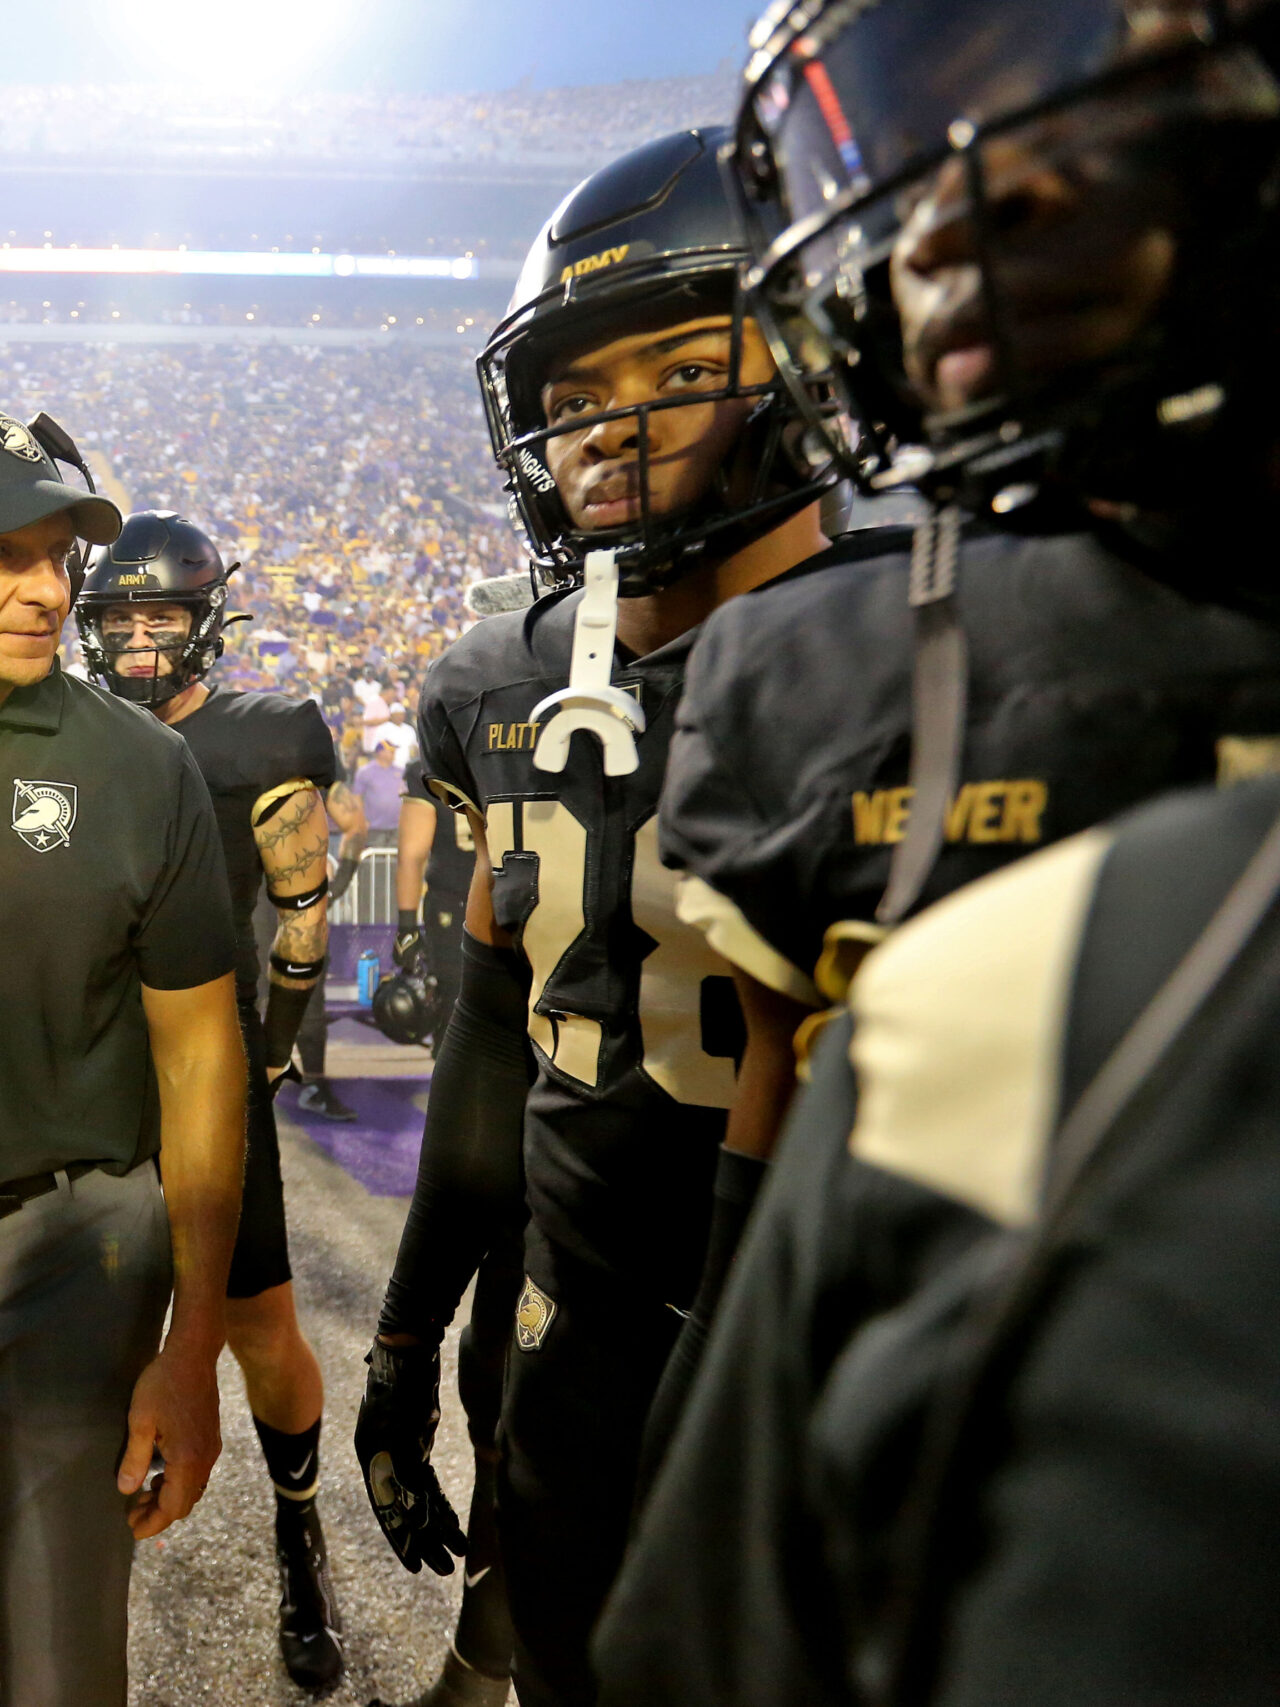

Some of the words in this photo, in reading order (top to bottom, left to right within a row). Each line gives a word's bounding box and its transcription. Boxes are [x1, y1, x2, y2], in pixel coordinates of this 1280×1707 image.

[561, 244, 630, 283] ARMY
[118, 574, 147, 586] ARMY
[489, 722, 541, 750] PLATT
[852, 780, 1048, 844] WEVER
